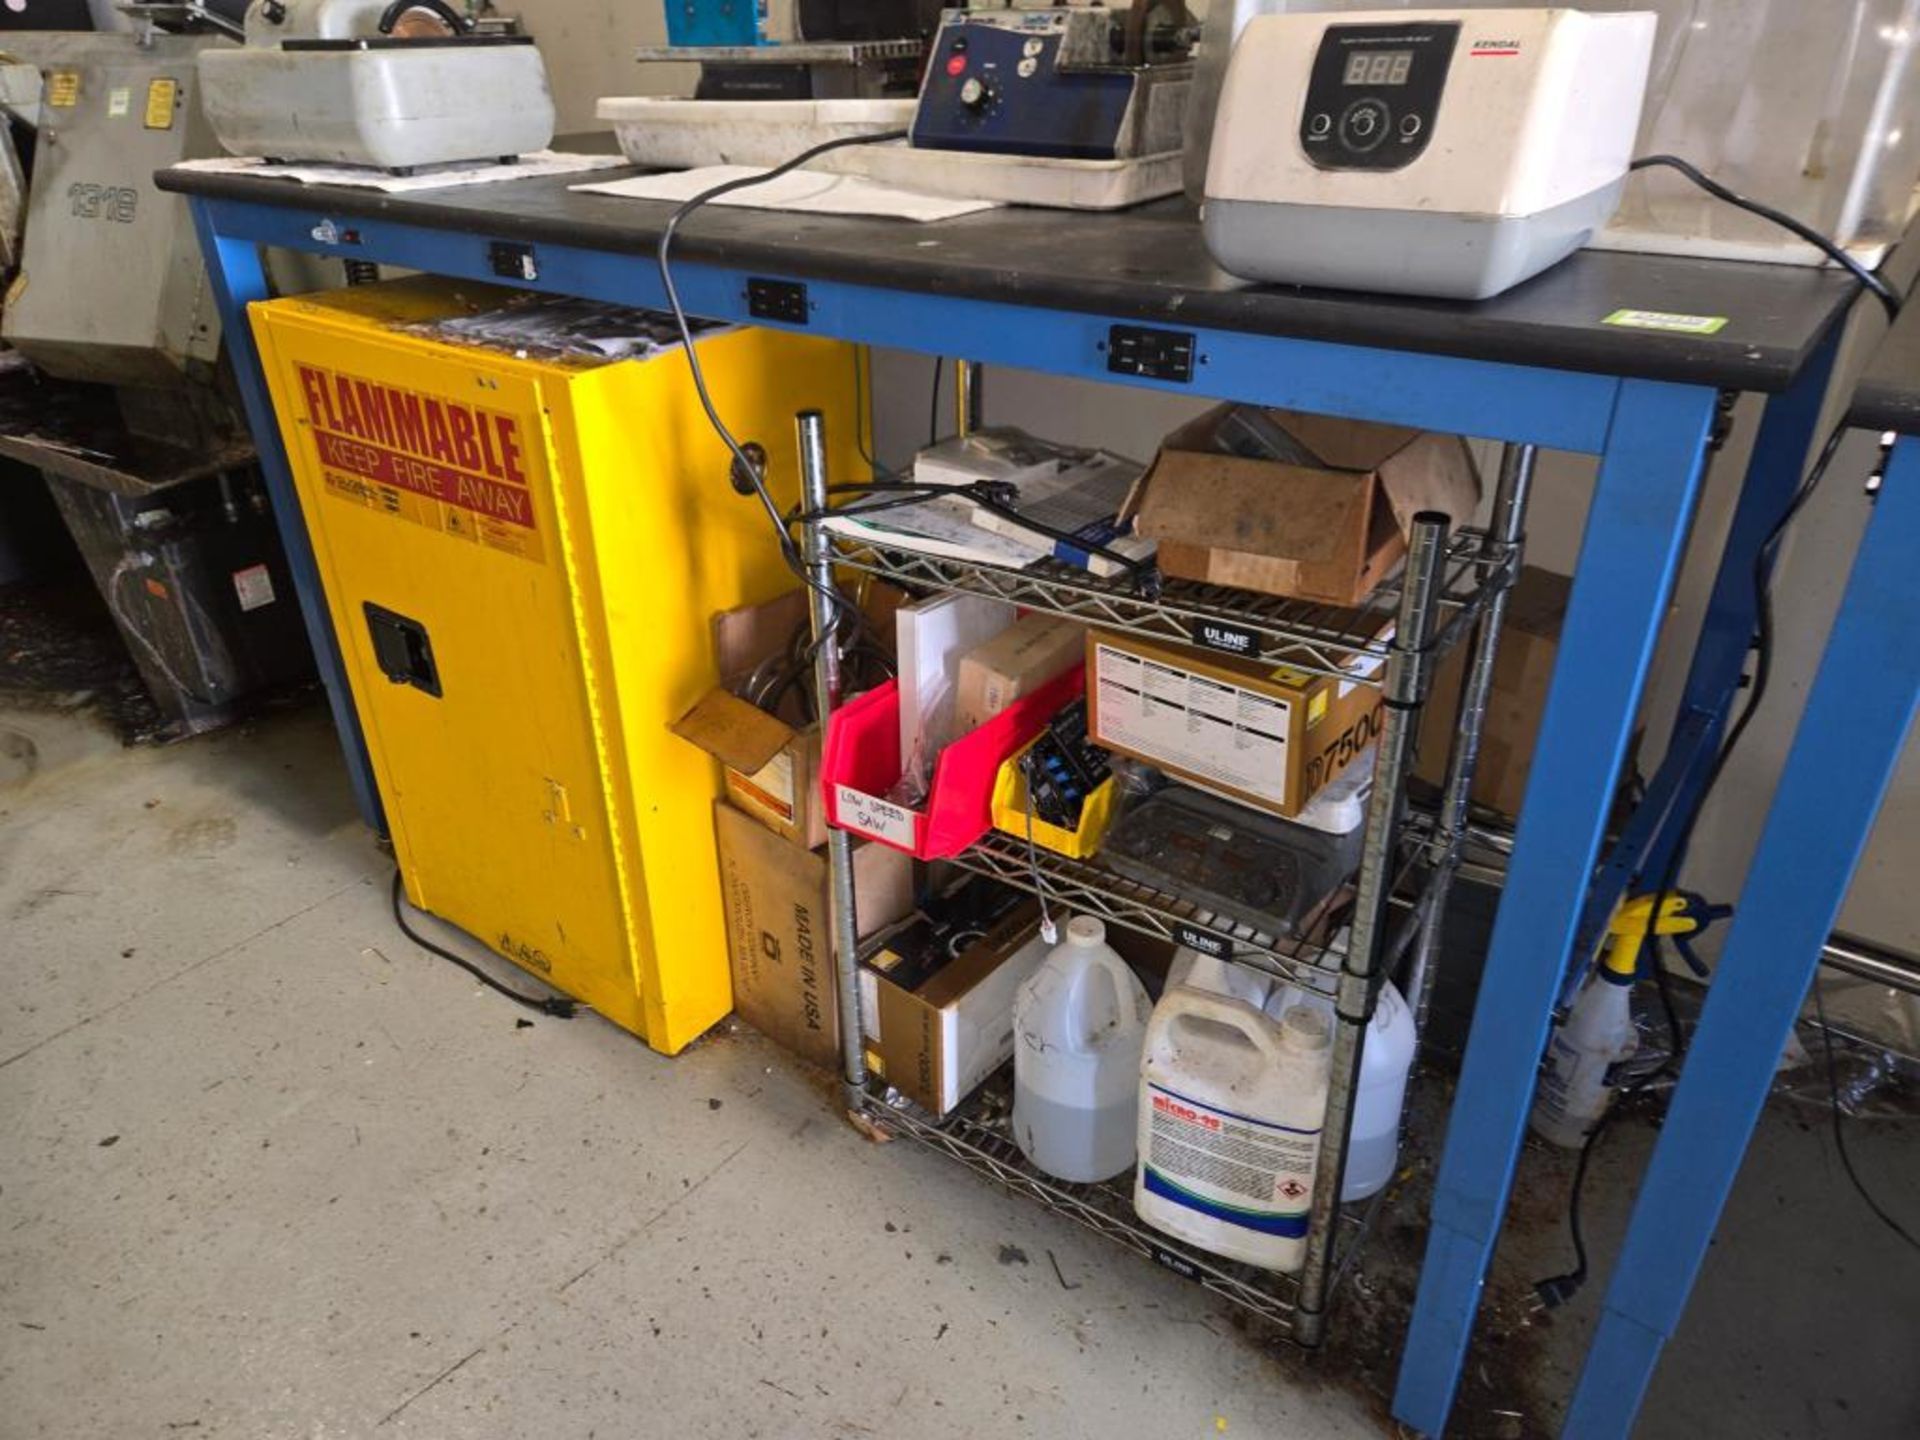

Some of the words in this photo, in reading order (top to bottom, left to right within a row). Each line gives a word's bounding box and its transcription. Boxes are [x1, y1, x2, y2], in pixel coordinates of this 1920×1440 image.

[1472, 39, 1520, 49] KENDAL
[67, 181, 138, 224] 1318
[299, 366, 526, 484] FLAMMABLE
[325, 435, 380, 474] KEEP
[391, 455, 444, 497] FIRE
[457, 475, 525, 521] AWAY
[1204, 626, 1250, 648] ULINE
[841, 789, 863, 806] LOW
[869, 800, 905, 822] SPEED
[857, 811, 887, 831] SAW
[794, 902, 814, 963] MADE
[1183, 930, 1222, 952] ULINE
[801, 965, 817, 989] IN
[803, 991, 821, 1030] USA
